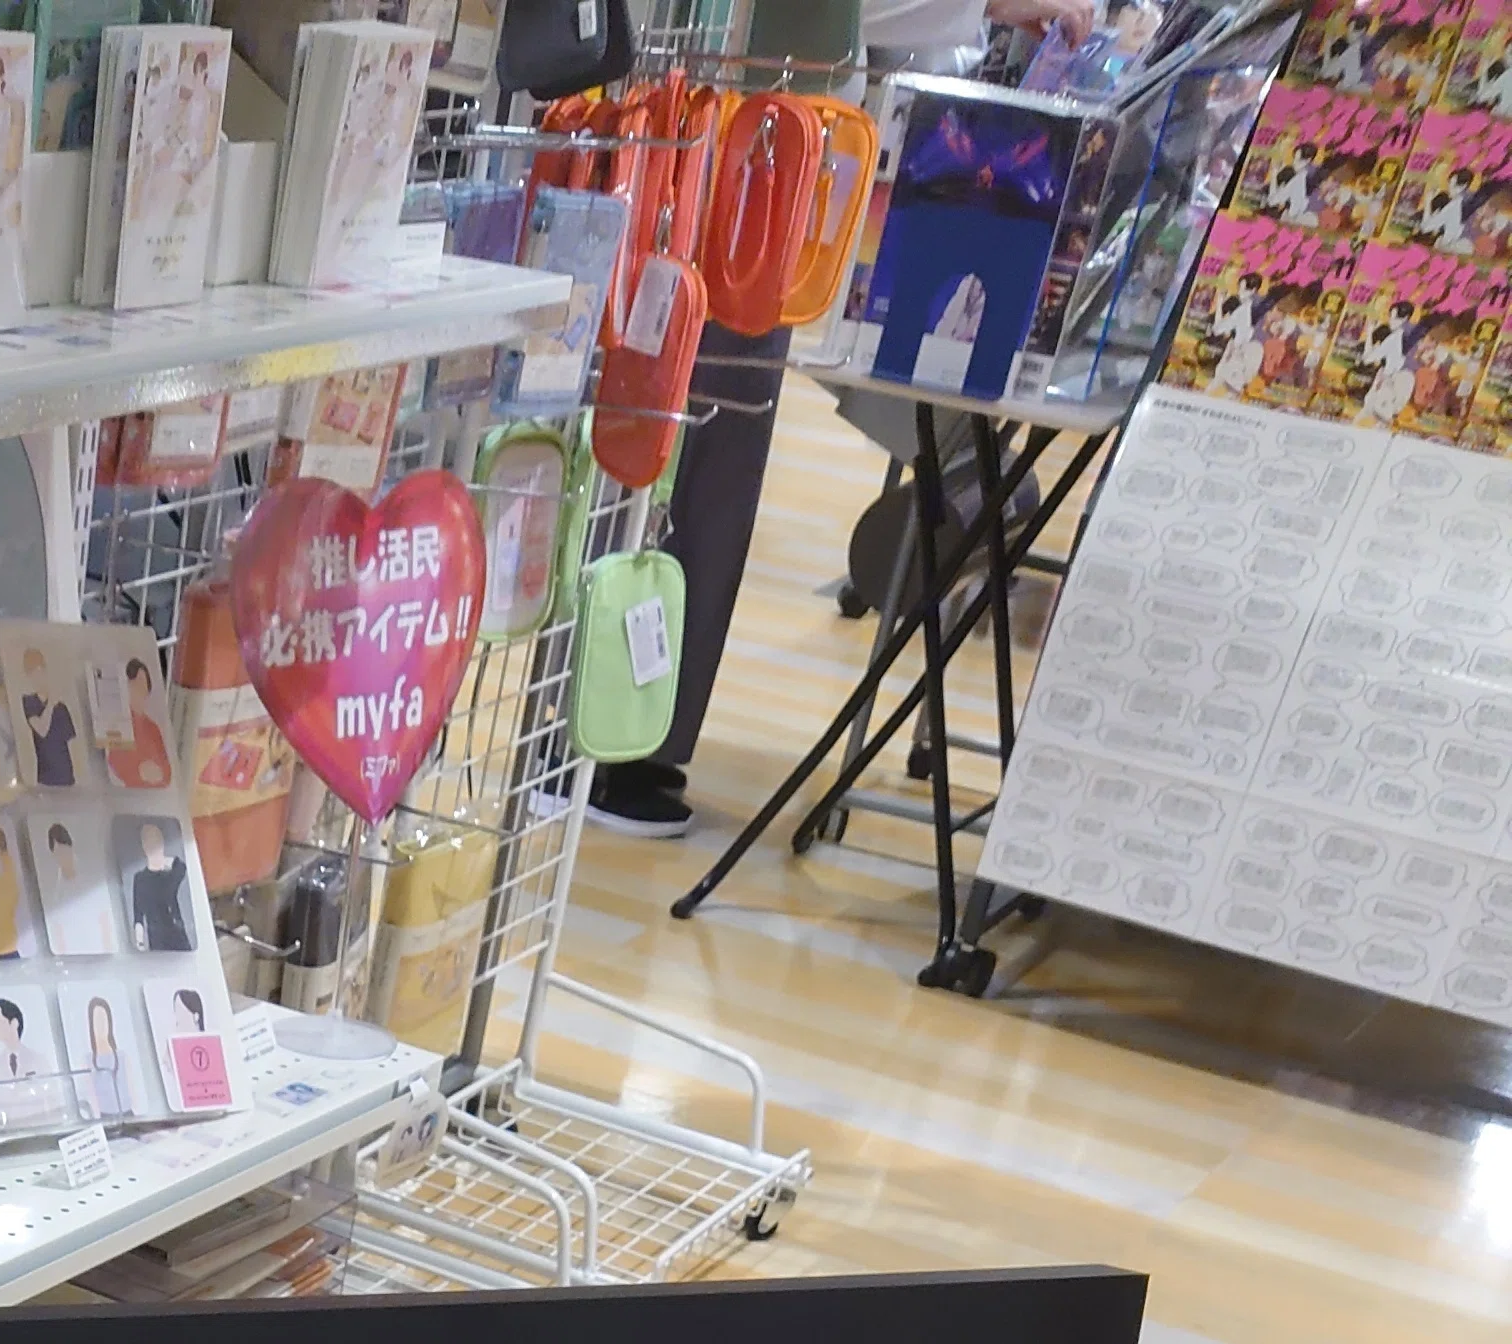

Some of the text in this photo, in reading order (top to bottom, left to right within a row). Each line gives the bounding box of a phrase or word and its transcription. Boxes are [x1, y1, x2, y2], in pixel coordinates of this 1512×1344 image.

[309, 525, 441, 589] 推し活民
[337, 674, 425, 741] myfa
